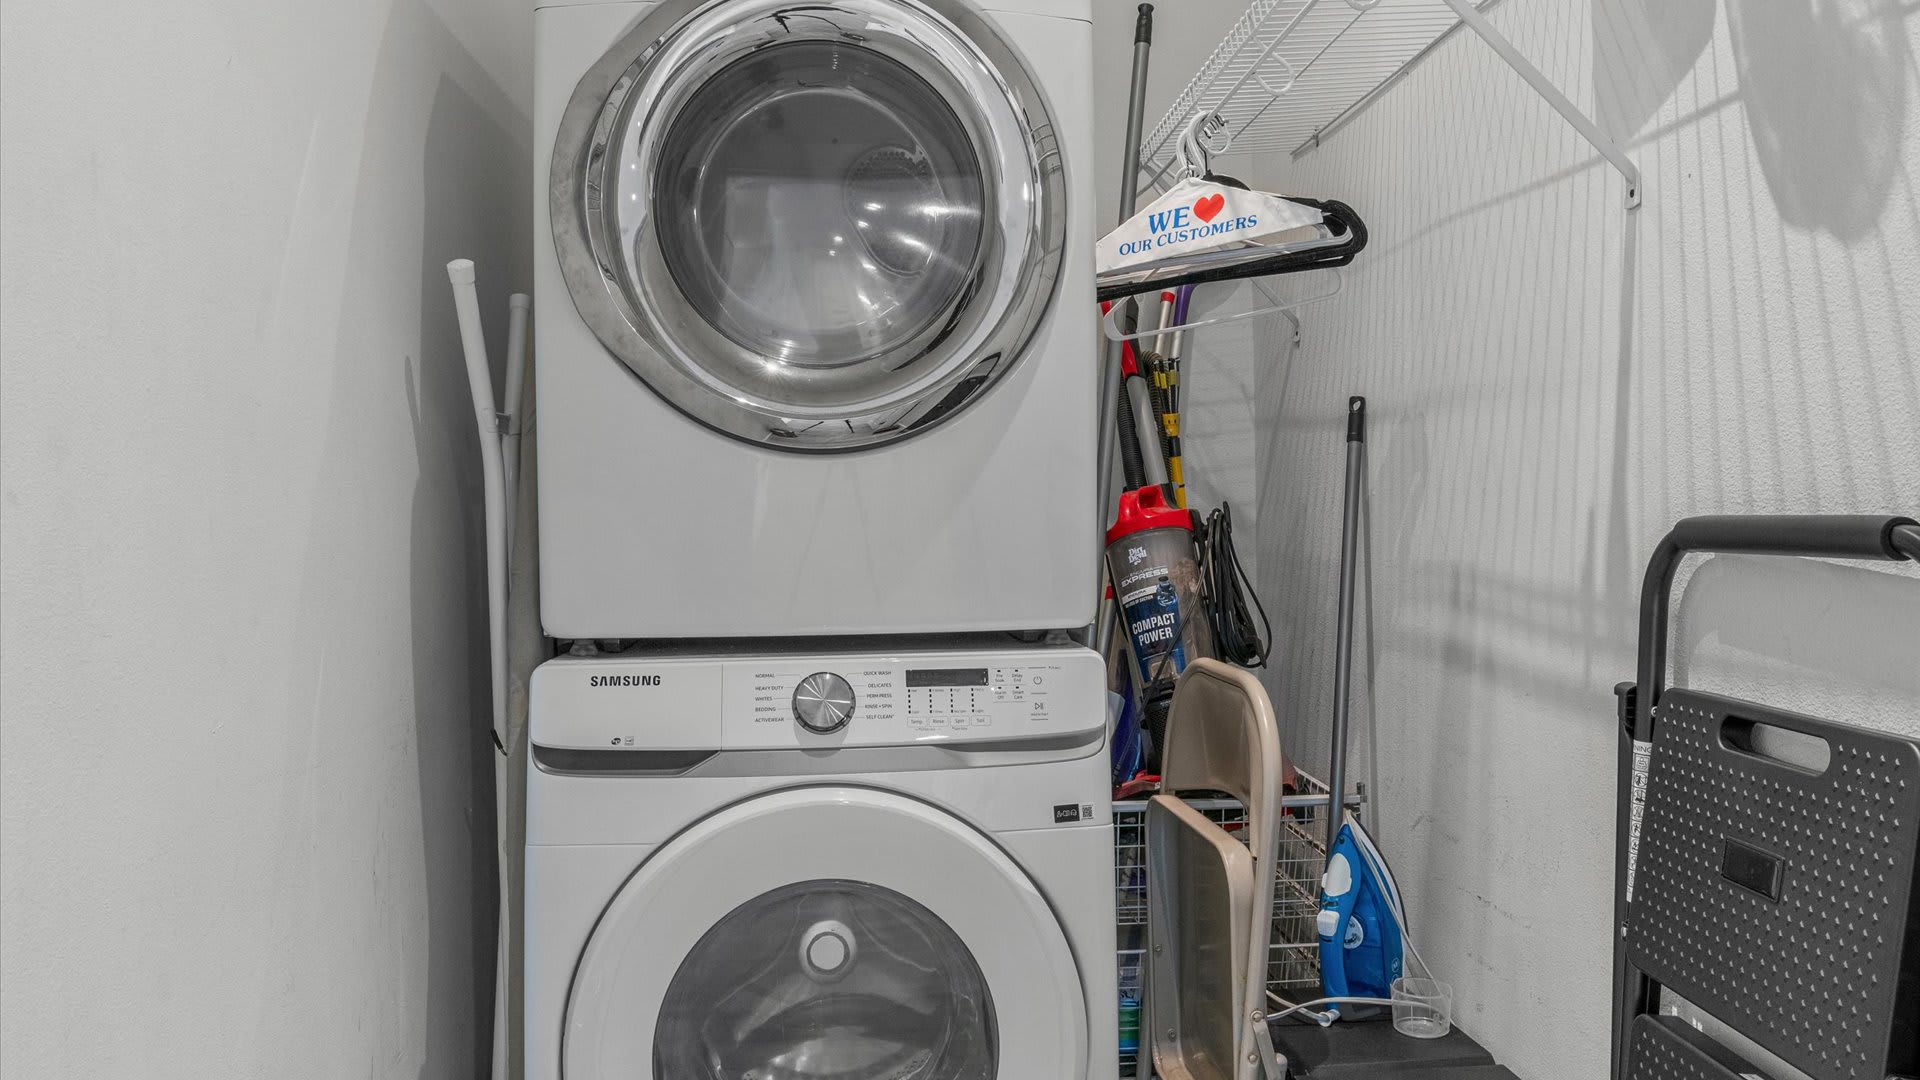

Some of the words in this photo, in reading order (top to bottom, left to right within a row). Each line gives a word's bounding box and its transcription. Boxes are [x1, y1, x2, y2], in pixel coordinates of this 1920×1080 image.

[1149, 206, 1190, 236] WE
[1119, 239, 1152, 256] OUR
[1156, 214, 1258, 247] CUSTOMERS
[1128, 546, 1143, 556] Dirt
[1128, 549, 1148, 564] Devil
[1121, 568, 1168, 588] EXPRESS
[1132, 612, 1175, 635] COMPACT
[1138, 627, 1173, 646] POWER
[590, 674, 661, 687] SAMSUNG
